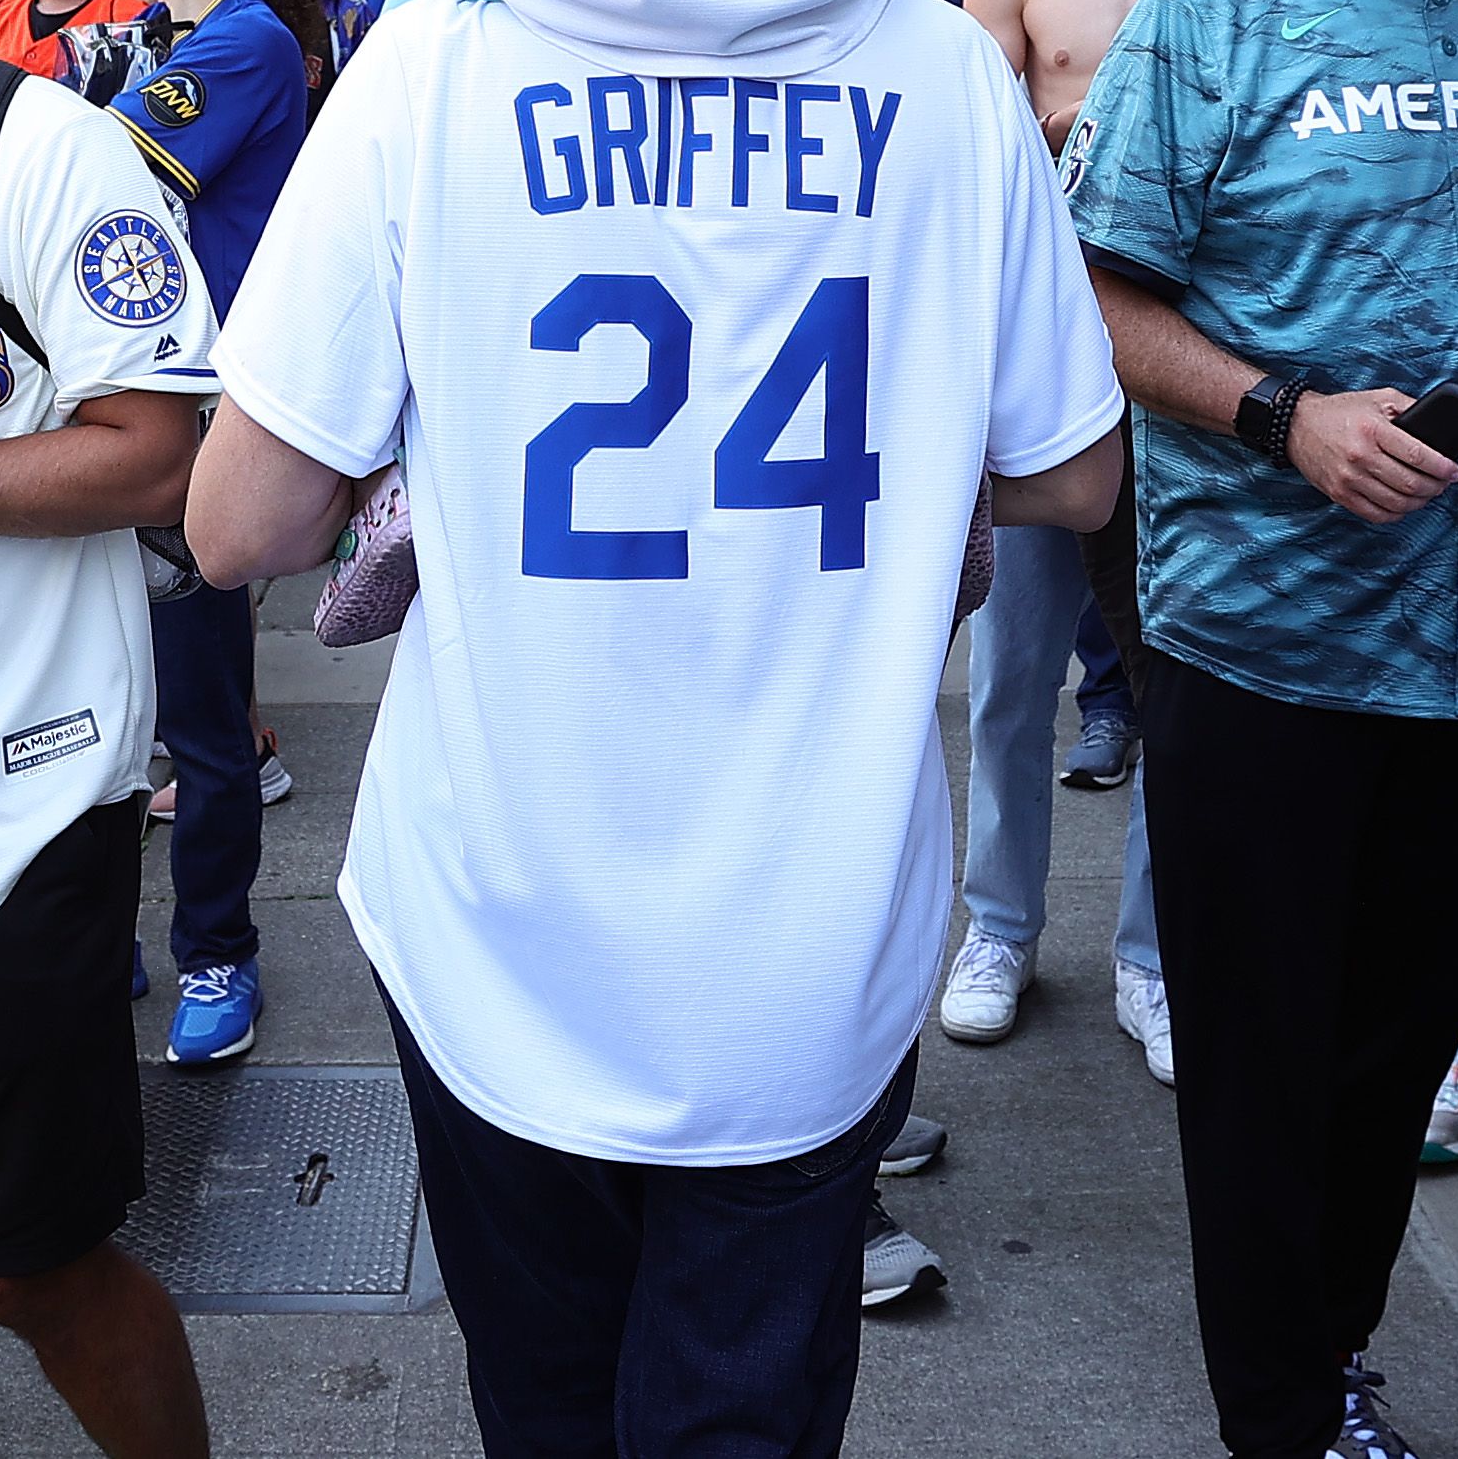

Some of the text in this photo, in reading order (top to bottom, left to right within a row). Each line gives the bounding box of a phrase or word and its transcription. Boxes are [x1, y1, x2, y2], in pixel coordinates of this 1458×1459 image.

[140, 79, 201, 119] PNW
[514, 74, 902, 218] GRIFFEY
[83, 218, 161, 274] SEATTLE
[102, 265, 180, 319] MARINERS
[521, 274, 880, 580] 24
[9, 759, 33, 772] MAJOR
[32, 750, 62, 765] LEAGUE
[30, 722, 88, 749] Majestic
